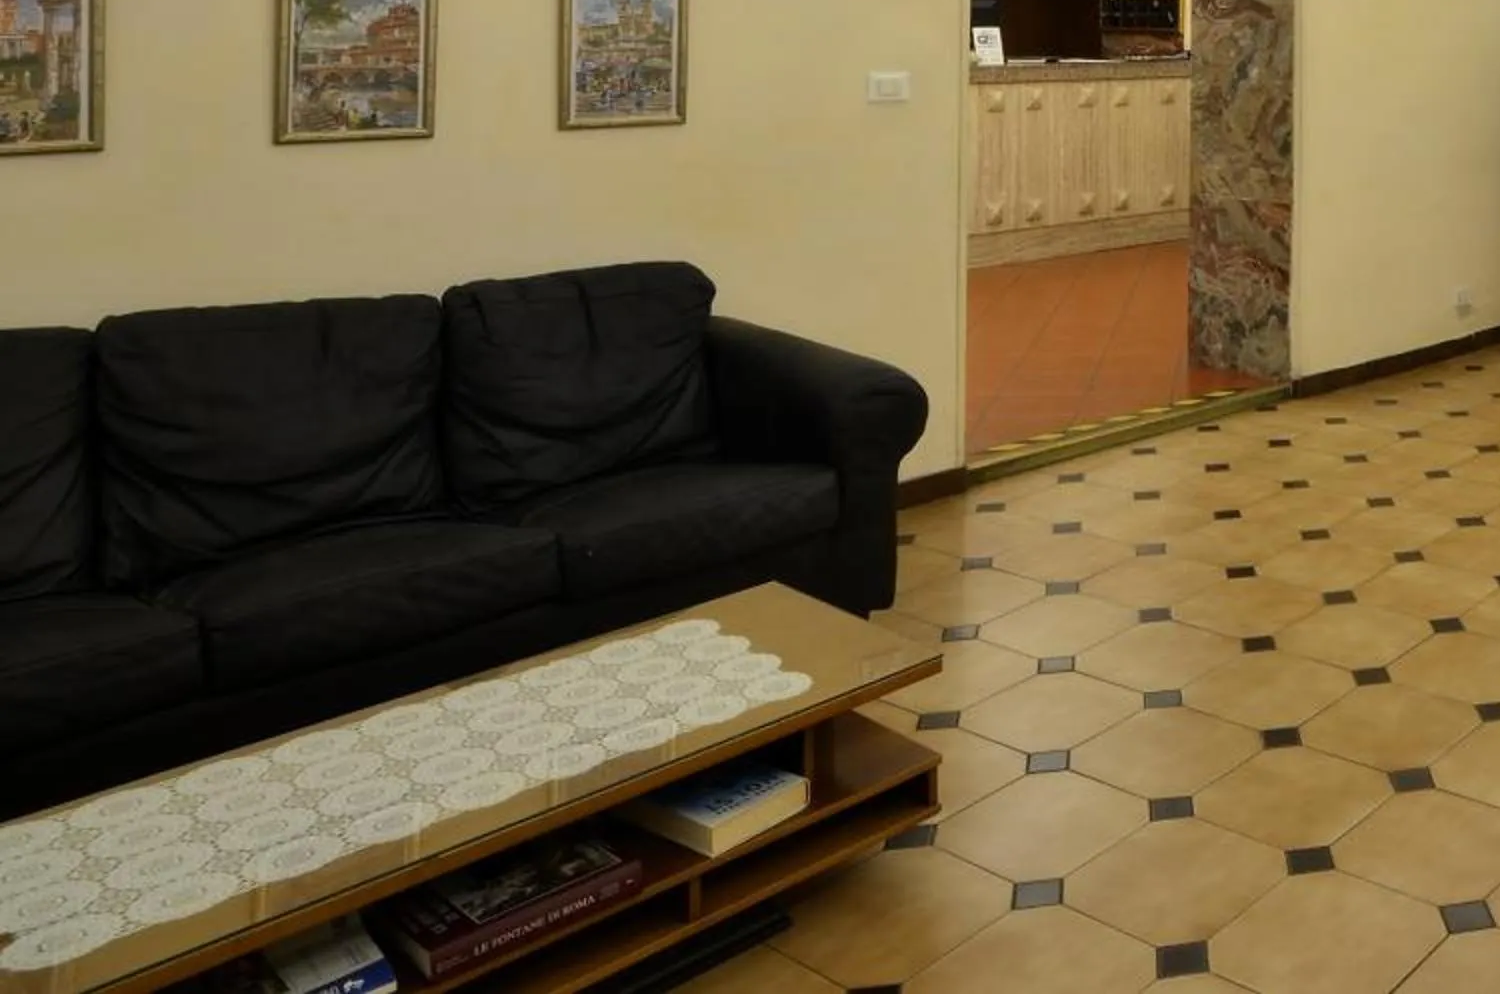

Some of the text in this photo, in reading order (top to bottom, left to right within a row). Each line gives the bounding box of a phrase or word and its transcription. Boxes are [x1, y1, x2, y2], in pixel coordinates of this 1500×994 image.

[474, 894, 597, 956] LE FONTANE DI ROMA
